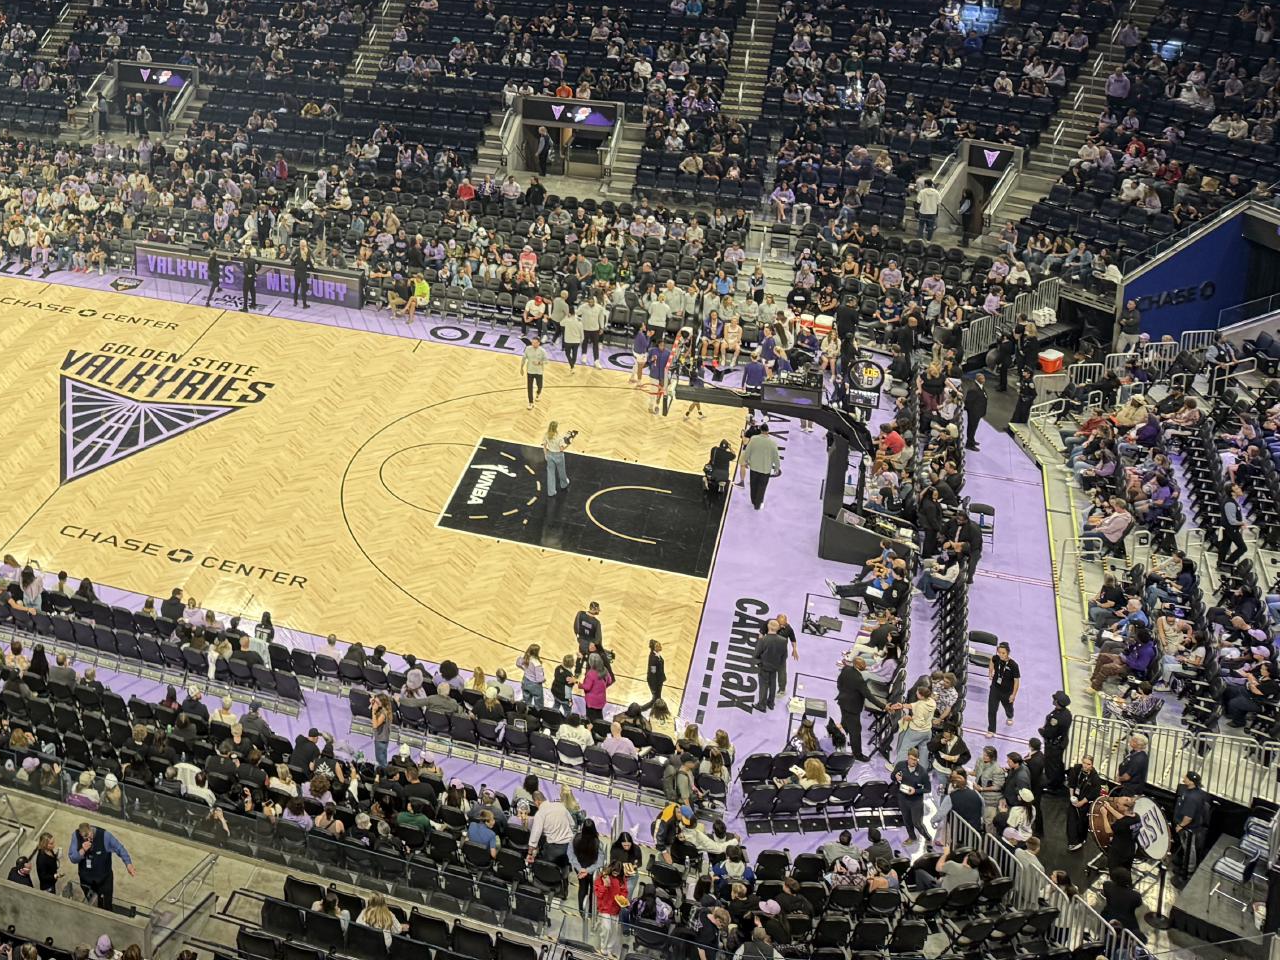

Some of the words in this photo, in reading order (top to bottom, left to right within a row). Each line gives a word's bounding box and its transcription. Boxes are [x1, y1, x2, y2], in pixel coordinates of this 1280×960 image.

[147, 254, 234, 286] VALKYRS
[266, 272, 347, 302] MEURY
[0, 297, 75, 315] CHASE
[101, 312, 179, 331] CENTER
[60, 349, 276, 404] VALKYRIES
[99, 342, 183, 365] GOLDEN
[187, 356, 260, 377] STATE
[467, 471, 497, 504] WNBA
[59, 525, 164, 557] CHASE
[200, 556, 308, 589] CENTER
